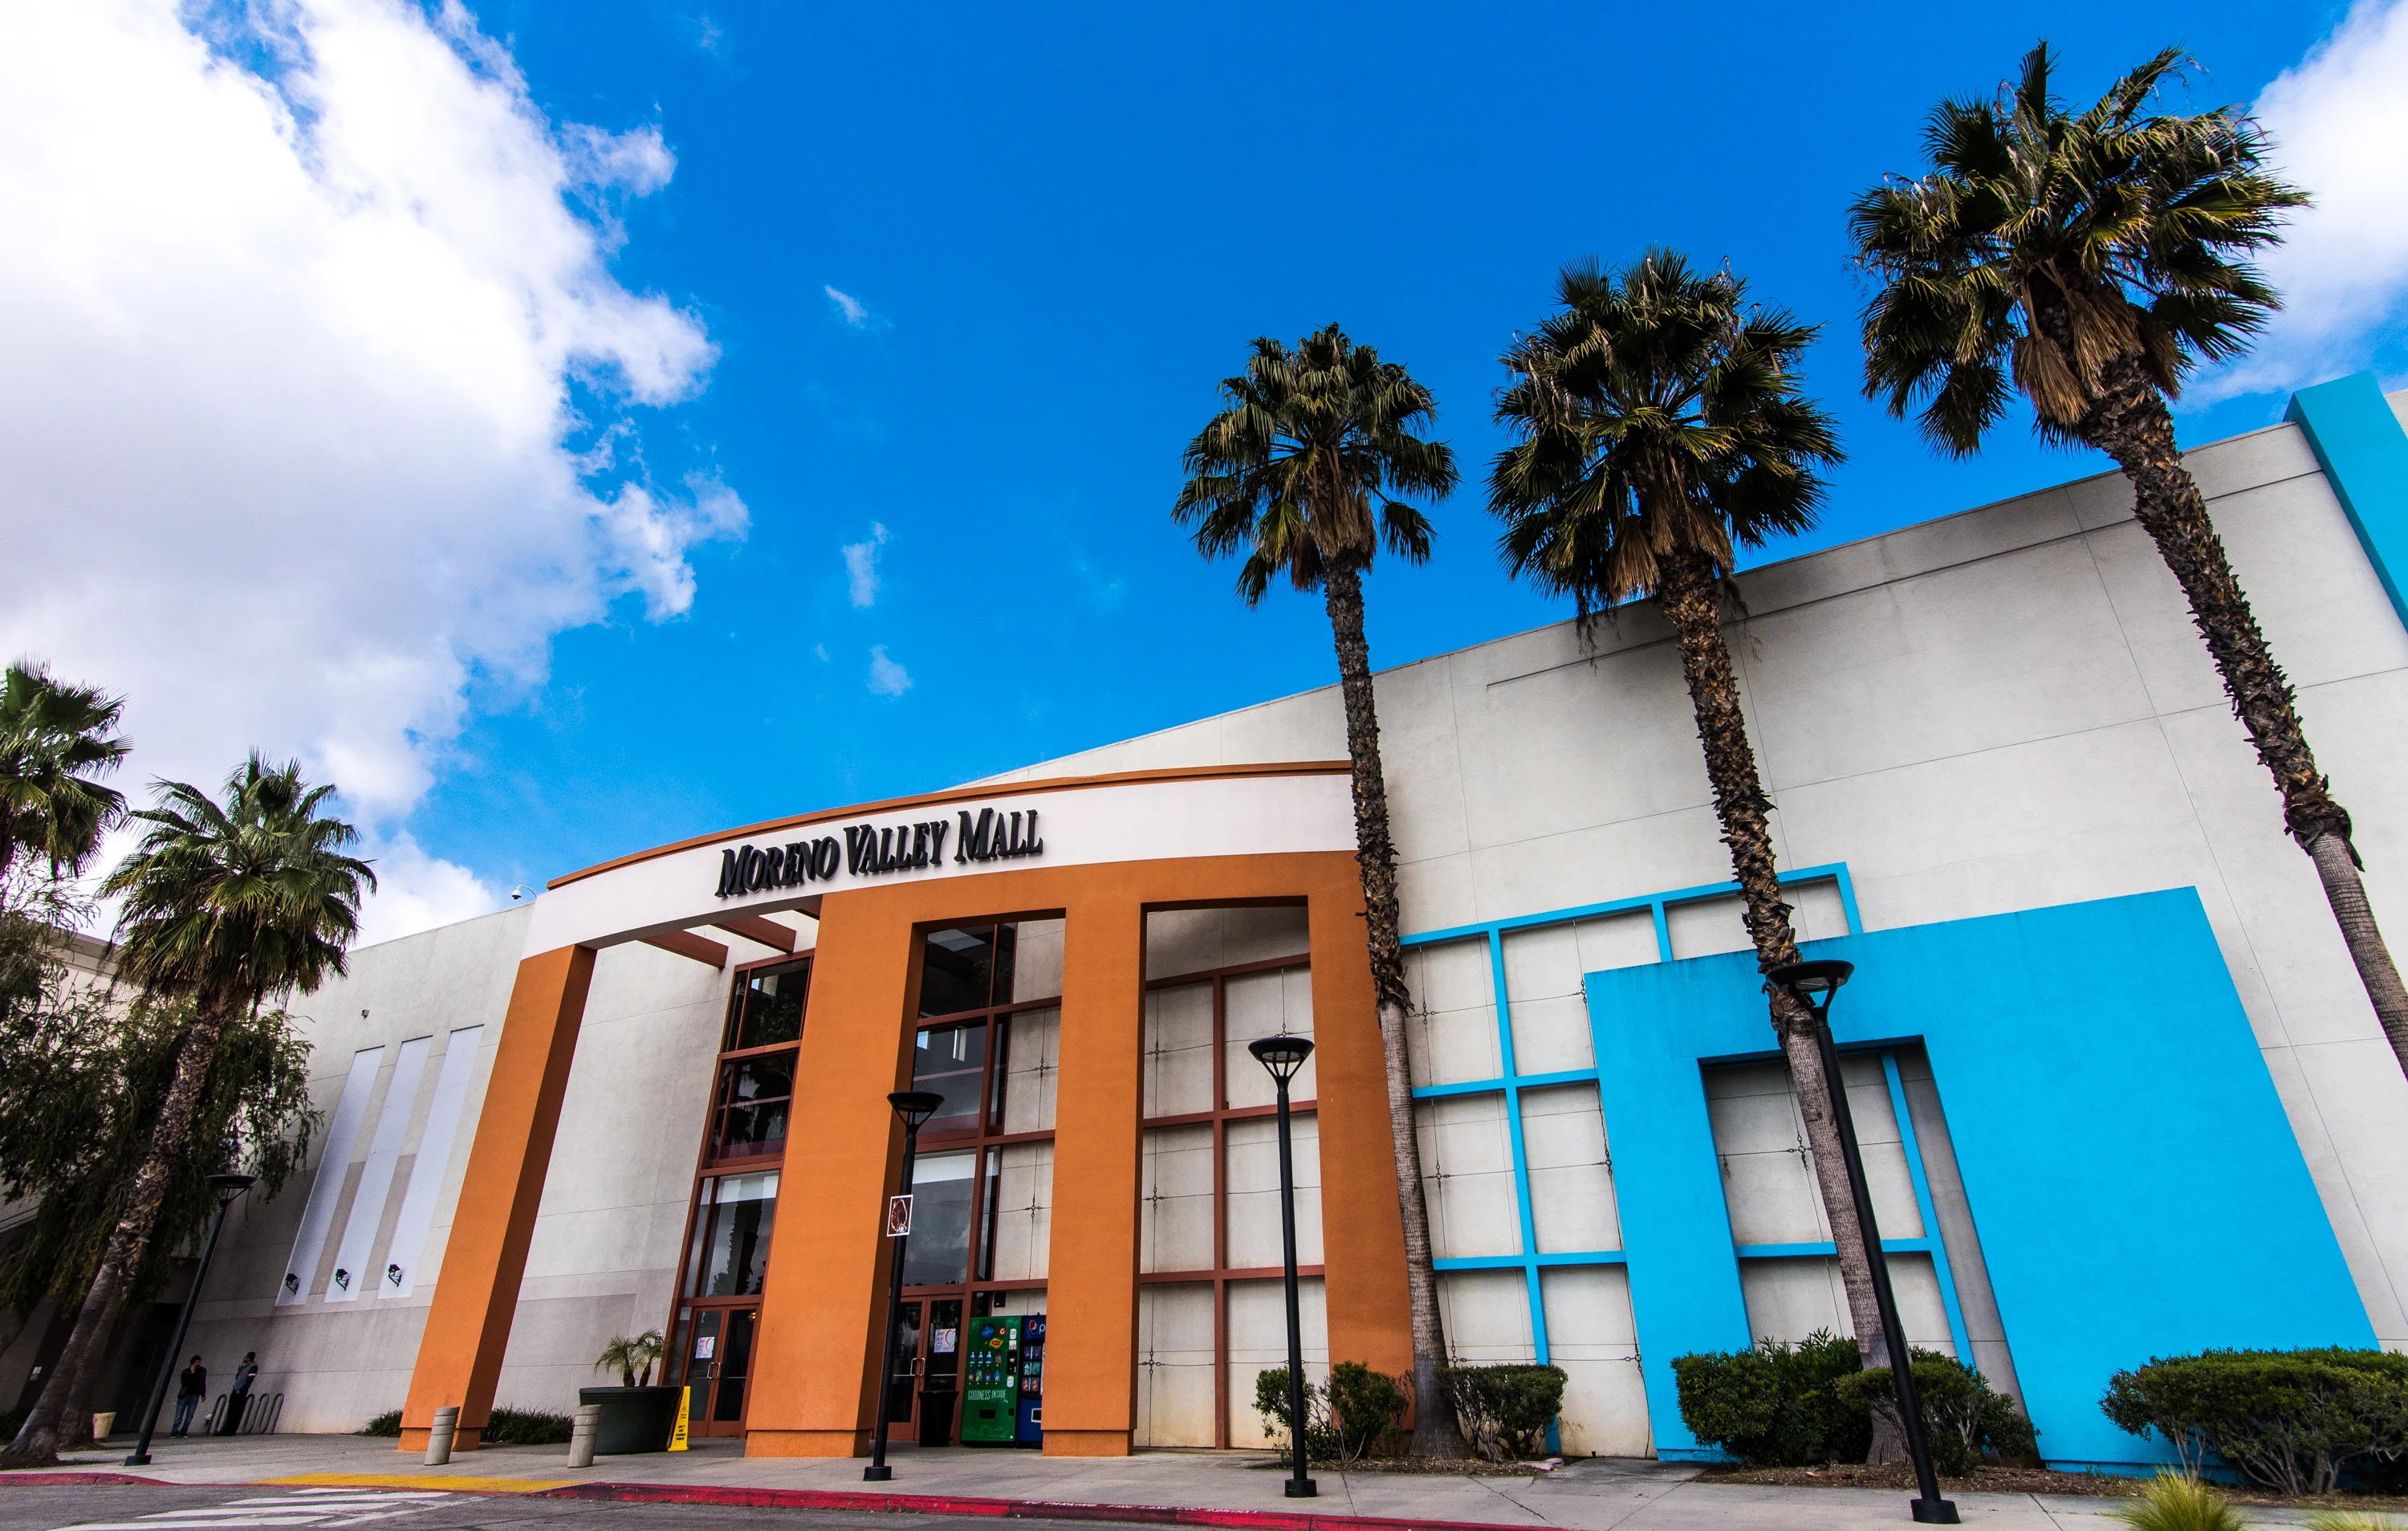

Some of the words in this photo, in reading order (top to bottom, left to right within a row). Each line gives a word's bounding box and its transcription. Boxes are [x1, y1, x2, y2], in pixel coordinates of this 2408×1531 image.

[714, 836, 840, 898] MORENO
[844, 820, 950, 876] VALLEY
[954, 807, 1043, 863] MALL
[967, 1390, 991, 1401] GOODNESS
[991, 1389, 1007, 1399] INSIDE
